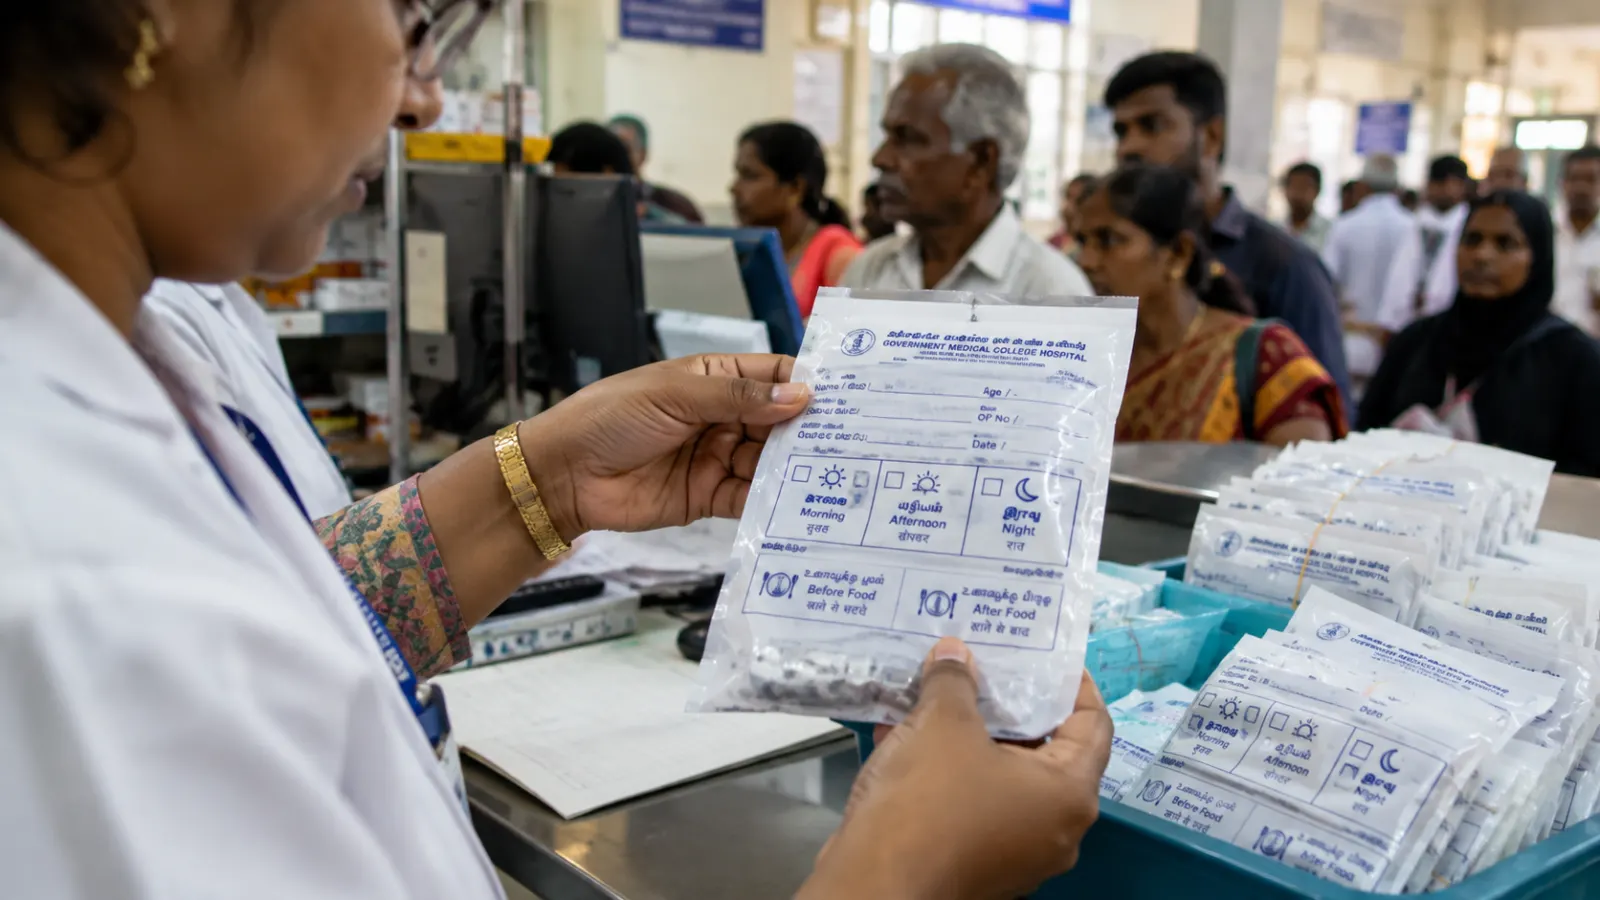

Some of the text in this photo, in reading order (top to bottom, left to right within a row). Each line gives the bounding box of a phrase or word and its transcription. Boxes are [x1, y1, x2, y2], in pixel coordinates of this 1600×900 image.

[883, 339, 945, 351] GOVERNMENT
[947, 343, 990, 353] MEDICAL
[992, 346, 1037, 356] COLLEGE
[1039, 349, 1088, 362] HOSPITAL
[983, 386, 1002, 398] Age
[977, 413, 992, 422] OP
[995, 414, 1010, 423] No
[972, 439, 997, 450] Date
[800, 507, 846, 523] Morning
[888, 515, 947, 530] Afternoon
[1001, 523, 1036, 537] Night
[807, 584, 877, 601] Before Food
[972, 603, 1037, 621] After Food
[1199, 807, 1224, 823] Food
